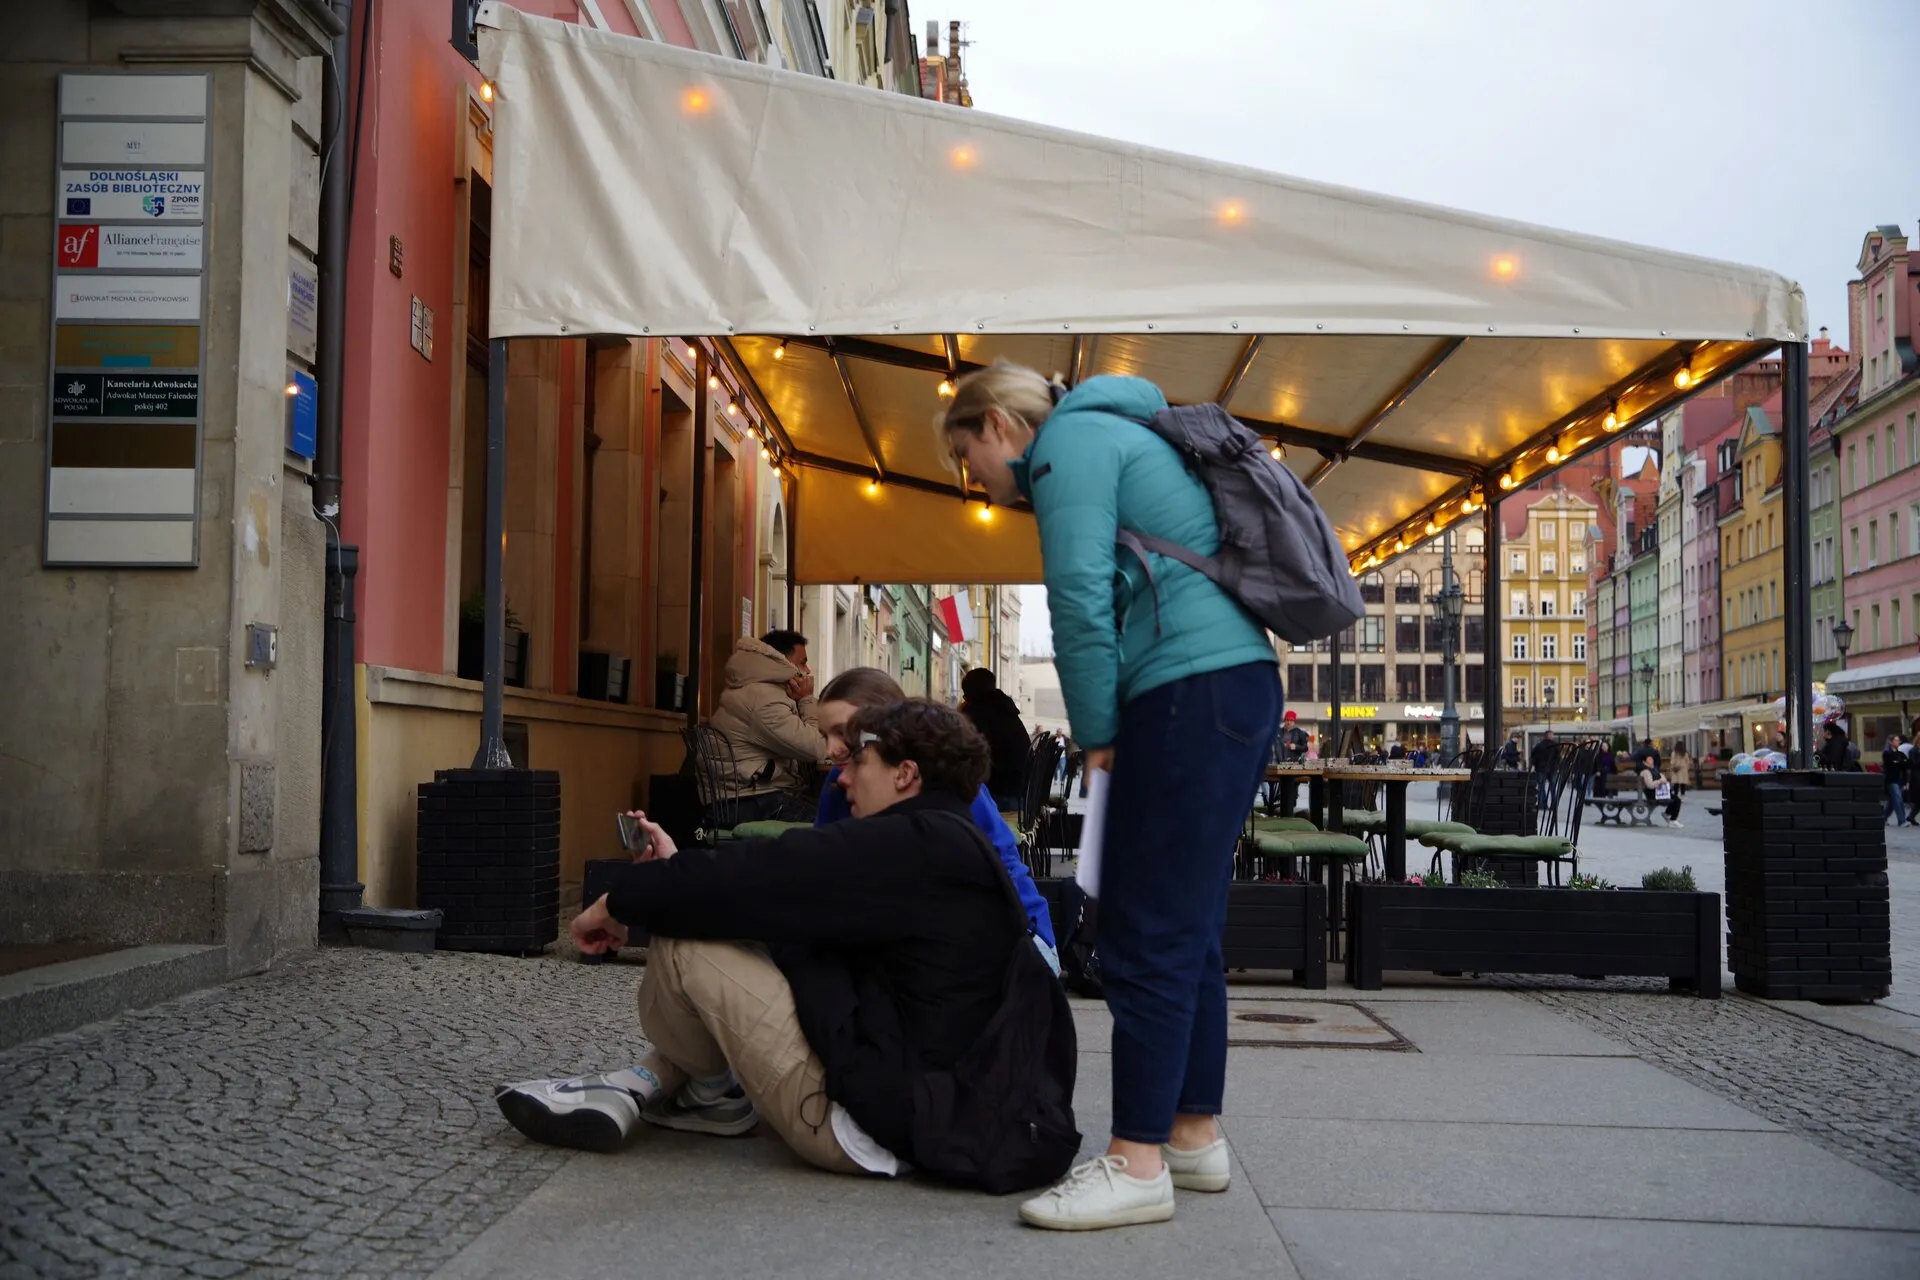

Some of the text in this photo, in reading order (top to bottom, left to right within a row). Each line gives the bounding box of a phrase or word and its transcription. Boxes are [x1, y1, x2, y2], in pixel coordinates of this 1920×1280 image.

[89, 170, 179, 183] DOLNOŚLĄSKI
[66, 181, 201, 193] ZASÓB BIBLIOTECZNY
[171, 195, 199, 203] ZPORR
[64, 227, 95, 264] af
[111, 295, 137, 303] MICHAŁ
[107, 380, 198, 389] Kancelaria Adwokacka
[134, 403, 154, 412] pokój
